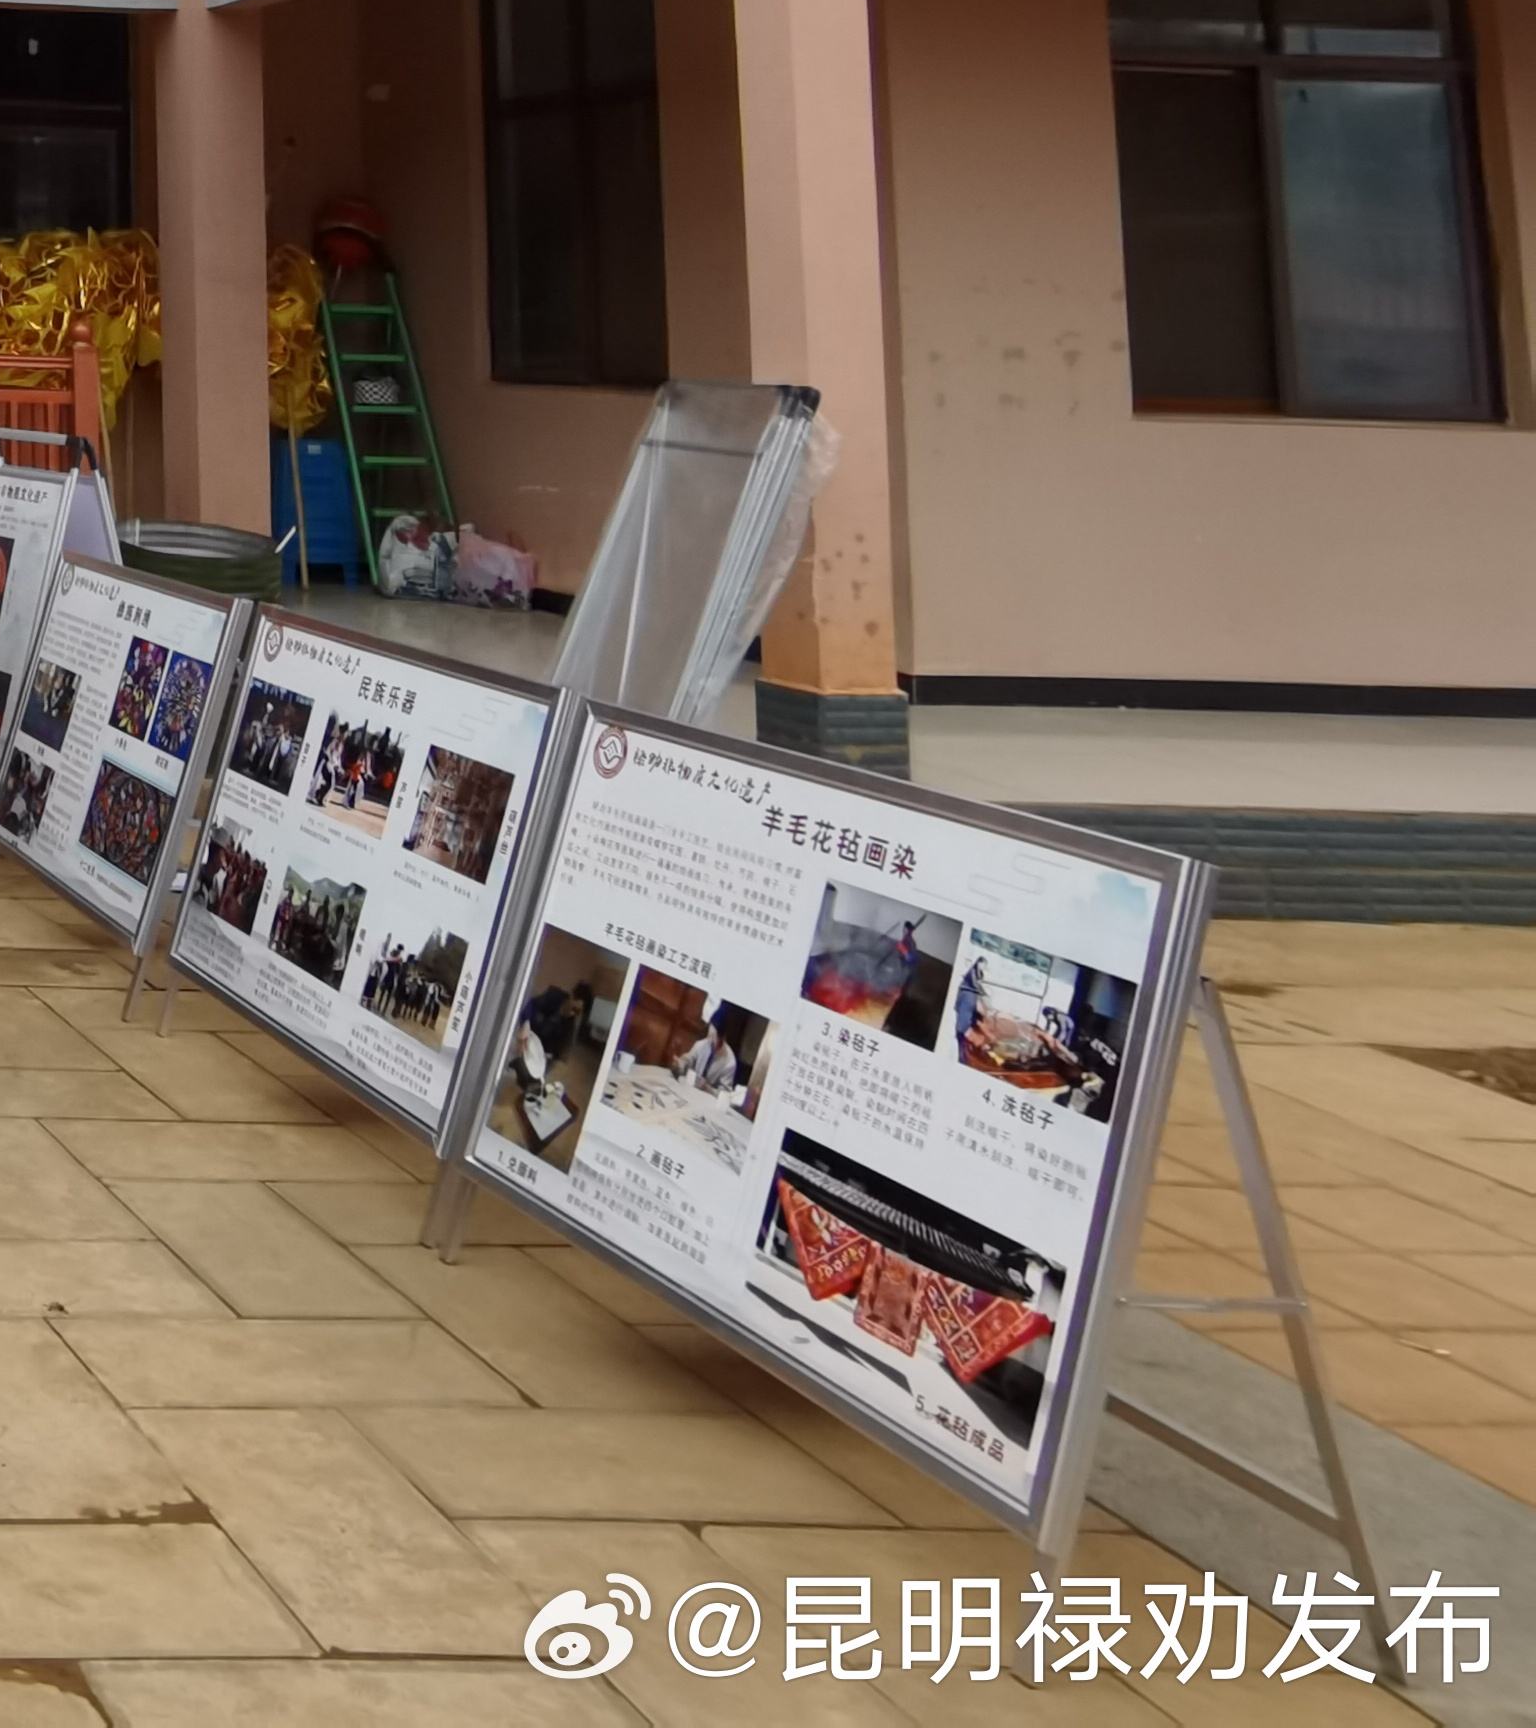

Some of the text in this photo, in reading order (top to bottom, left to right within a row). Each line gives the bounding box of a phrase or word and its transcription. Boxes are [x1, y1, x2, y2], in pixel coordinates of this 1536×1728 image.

[358, 675, 417, 715] 民族乐器
[761, 804, 917, 881] 羊毛花毡画染
